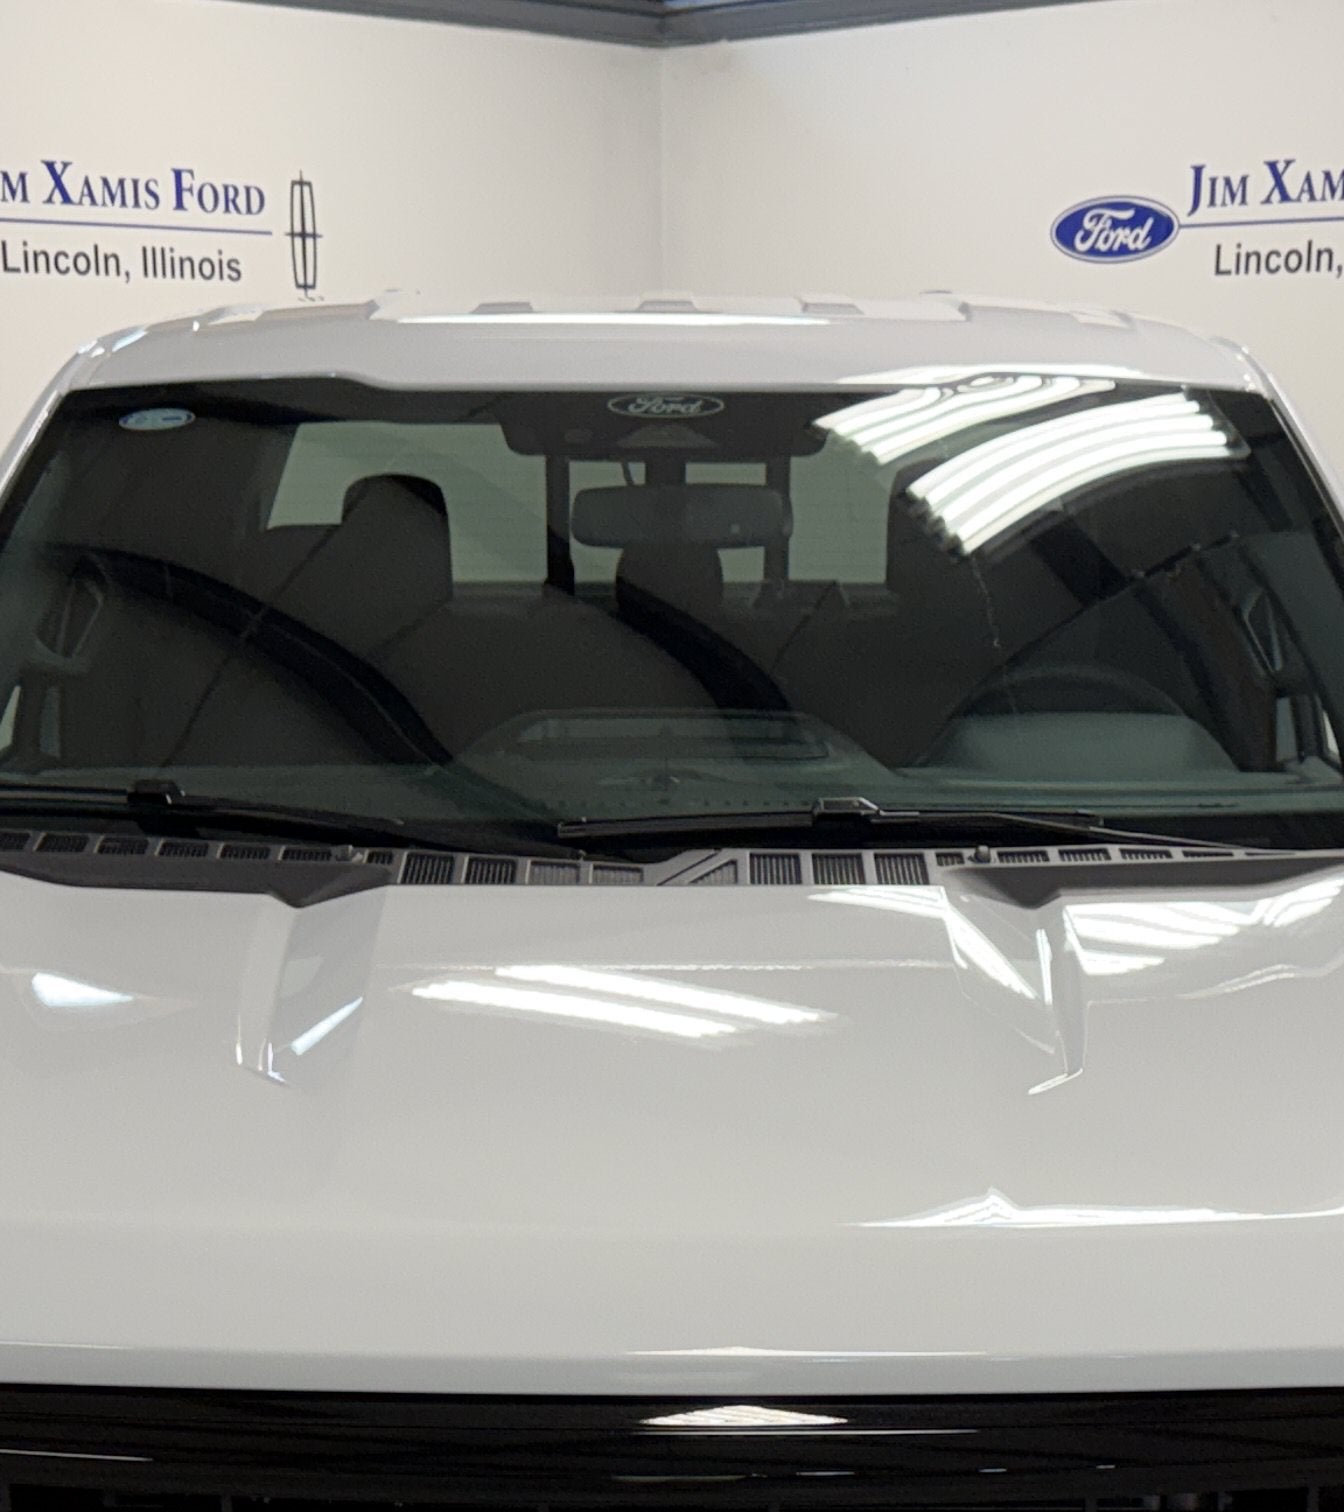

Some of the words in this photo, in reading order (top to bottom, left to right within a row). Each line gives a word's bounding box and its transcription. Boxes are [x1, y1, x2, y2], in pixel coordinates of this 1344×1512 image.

[41, 159, 159, 206] XAMIS
[171, 168, 266, 215] FORD
[1187, 164, 1249, 216] JIM
[1073, 208, 1153, 252] Ford
[1, 240, 130, 283] Lincoln,
[141, 246, 242, 282] Illinois
[1214, 240, 1343, 279] Lincoln,
[628, 396, 703, 413] Ford
